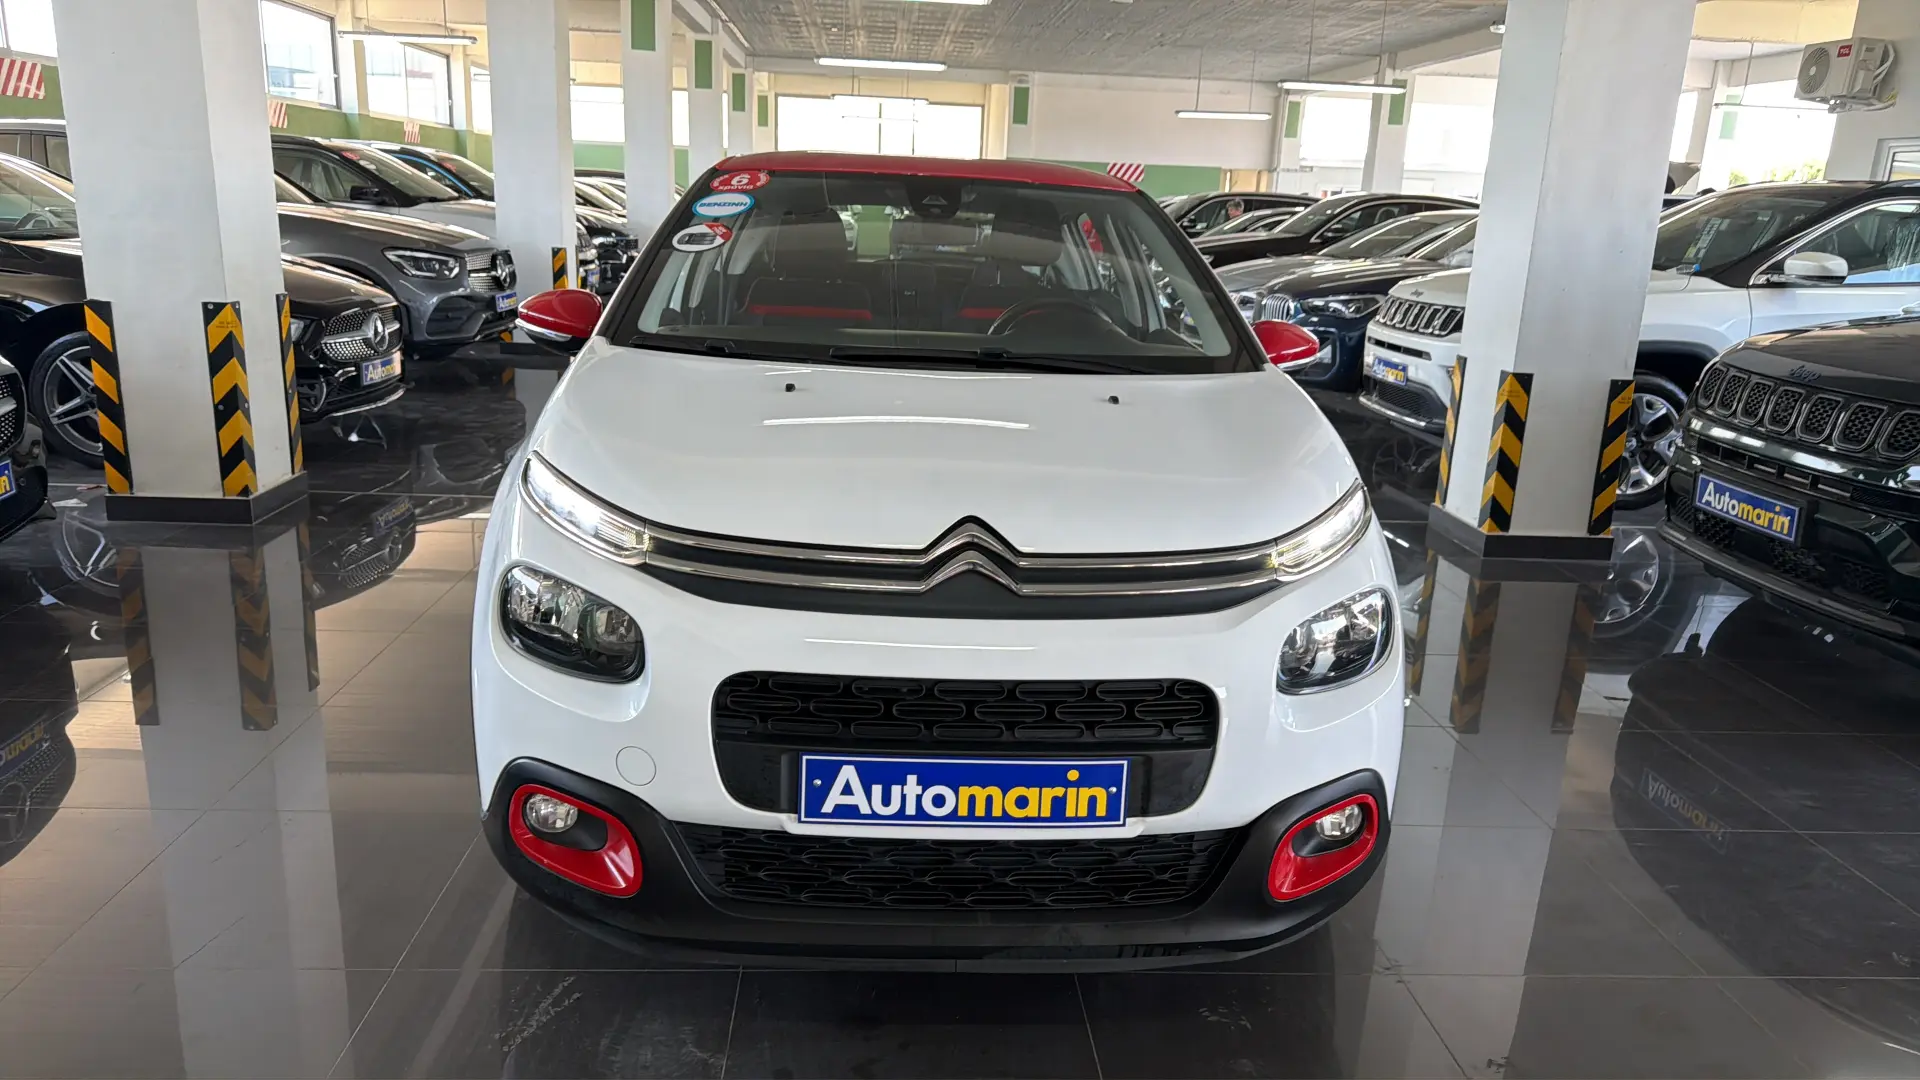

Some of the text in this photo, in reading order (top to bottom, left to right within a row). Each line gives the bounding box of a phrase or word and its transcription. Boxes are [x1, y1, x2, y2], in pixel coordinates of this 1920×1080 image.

[731, 174, 751, 185] 6
[1702, 482, 1790, 534] Automarin
[820, 765, 1107, 817] Automarin
